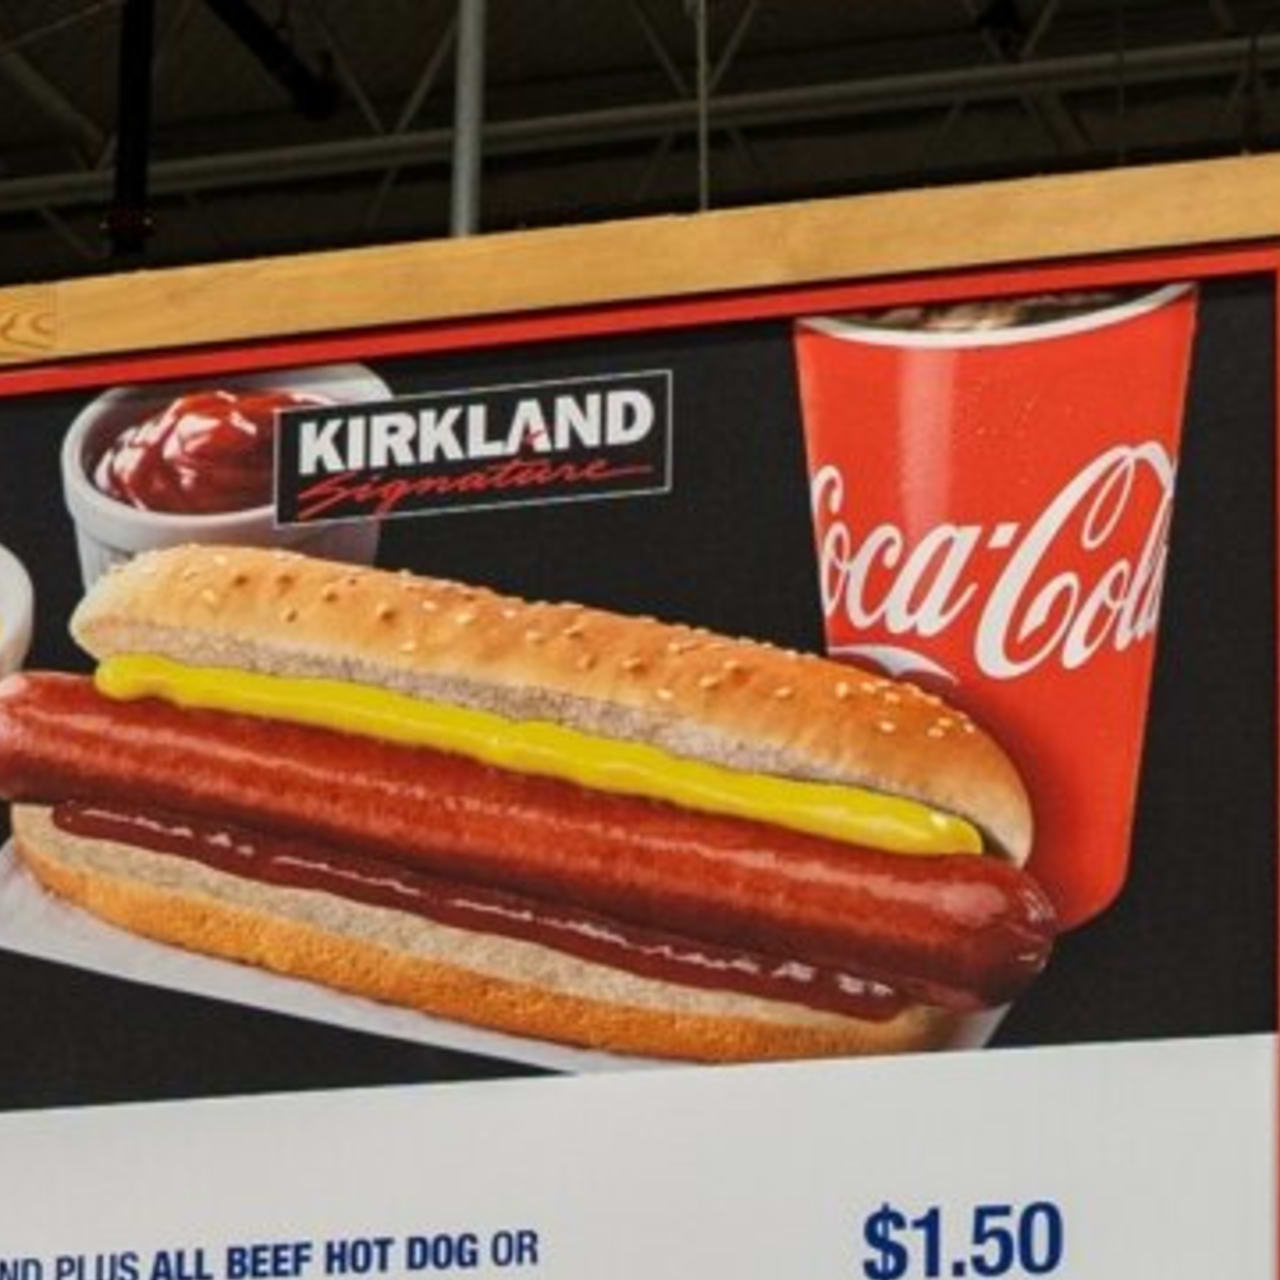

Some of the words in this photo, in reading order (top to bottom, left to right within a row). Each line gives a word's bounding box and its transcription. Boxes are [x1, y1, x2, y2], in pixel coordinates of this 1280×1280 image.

[298, 389, 654, 475] KIRKLAND
[297, 458, 653, 521] Signature
[226, 1242, 312, 1280] BEEF
[325, 1238, 394, 1274] HOT
[406, 1234, 479, 1270] DOG
[491, 1230, 539, 1266] OR
